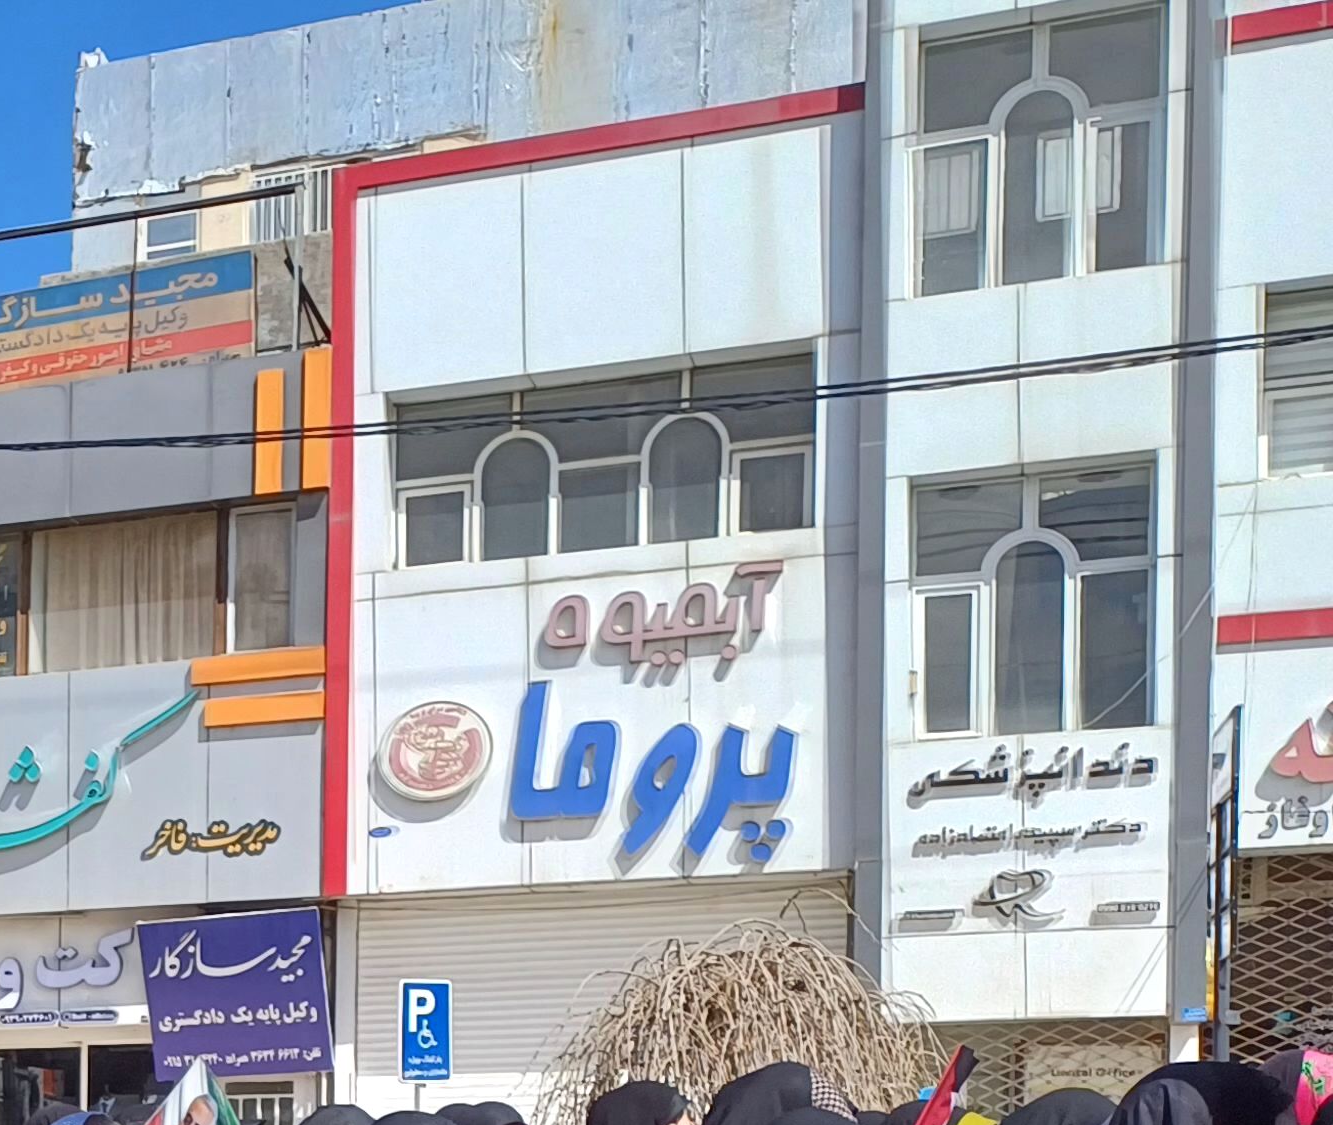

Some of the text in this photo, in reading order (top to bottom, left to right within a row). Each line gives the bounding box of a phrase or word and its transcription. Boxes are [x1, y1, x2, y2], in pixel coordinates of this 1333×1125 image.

[110, 272, 218, 306] مجید
[144, 306, 189, 334] وکیل
[544, 561, 784, 667] آبمیوه
[510, 681, 799, 862] پروما
[140, 819, 188, 861] فاخر
[37, 927, 134, 989] کت
[149, 929, 313, 982] مجید سازگار
[158, 1001, 318, 1033] وکیل پایه یک دادگستری
[408, 989, 436, 1033] P
